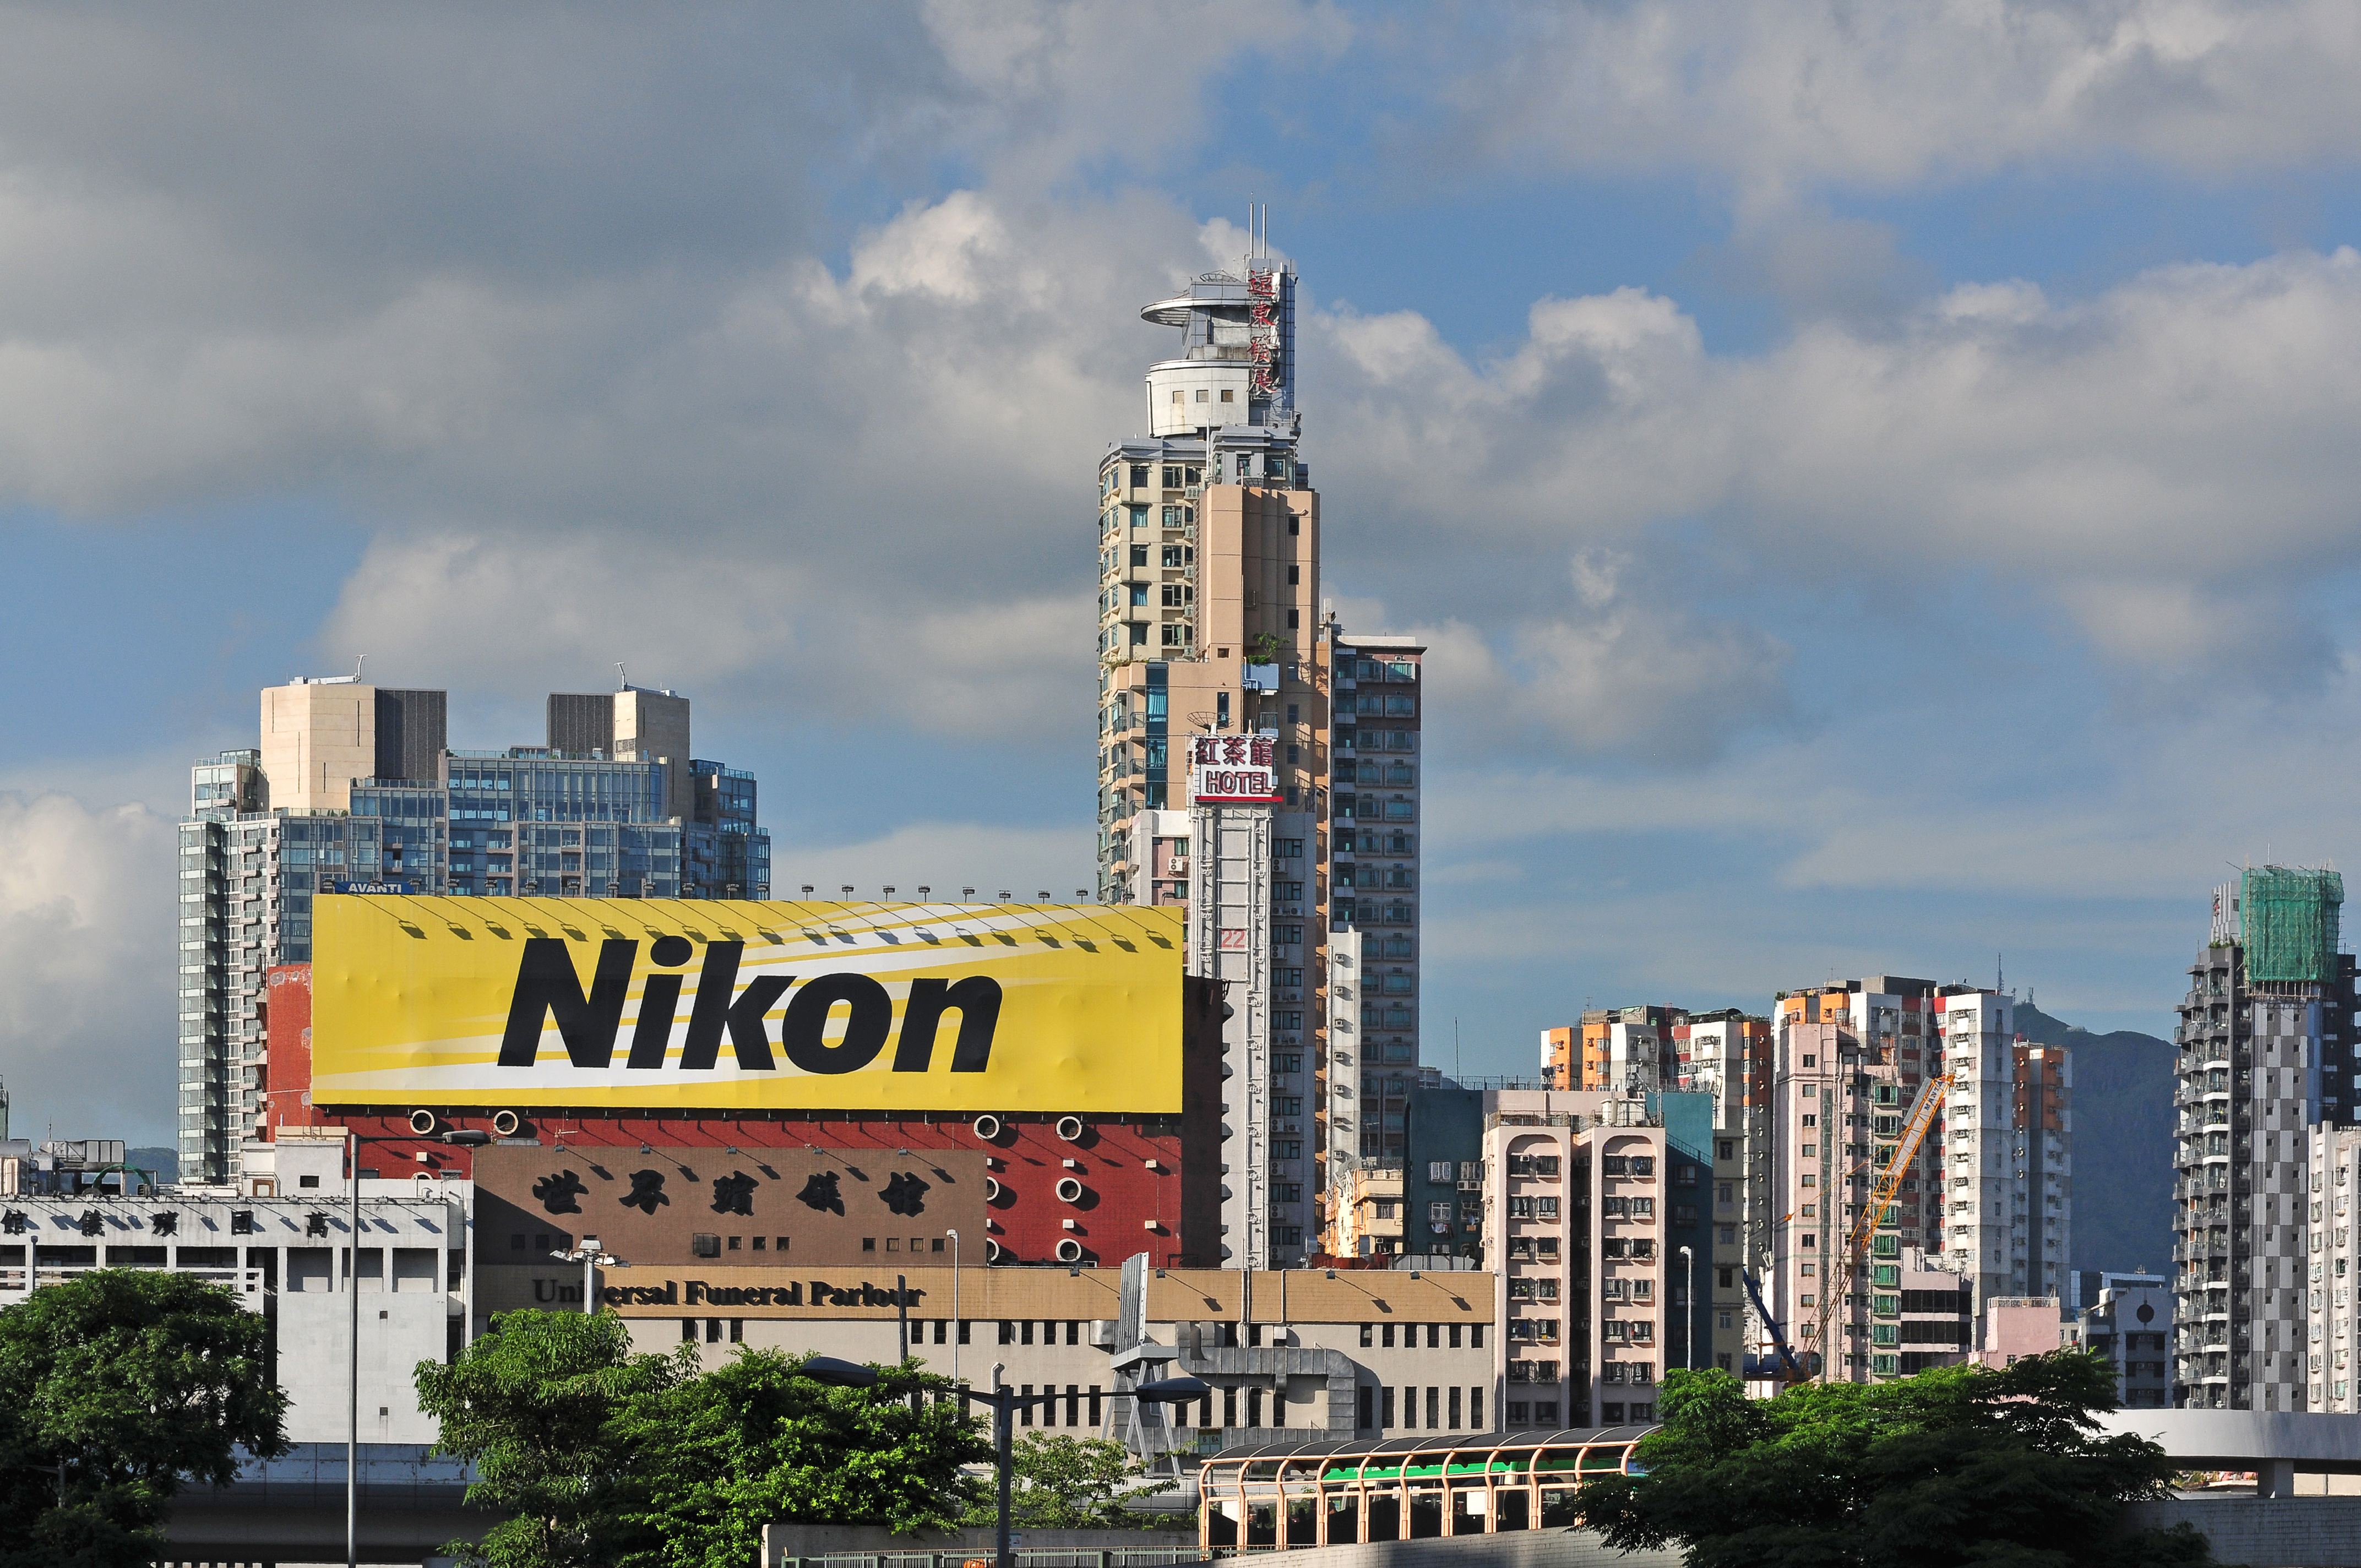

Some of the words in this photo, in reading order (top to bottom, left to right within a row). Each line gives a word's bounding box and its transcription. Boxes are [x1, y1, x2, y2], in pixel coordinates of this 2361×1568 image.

[1246, 267, 1277, 394] 遠東發展
[1195, 737, 1274, 766] 紅茶館
[1206, 770, 1273, 794] HOTEL
[348, 883, 401, 893] AVANTI
[1221, 928, 1245, 948] 22
[497, 935, 1003, 1075] Nikon
[682, 1280, 804, 1306] Funeral
[808, 1281, 927, 1308] Parlour
